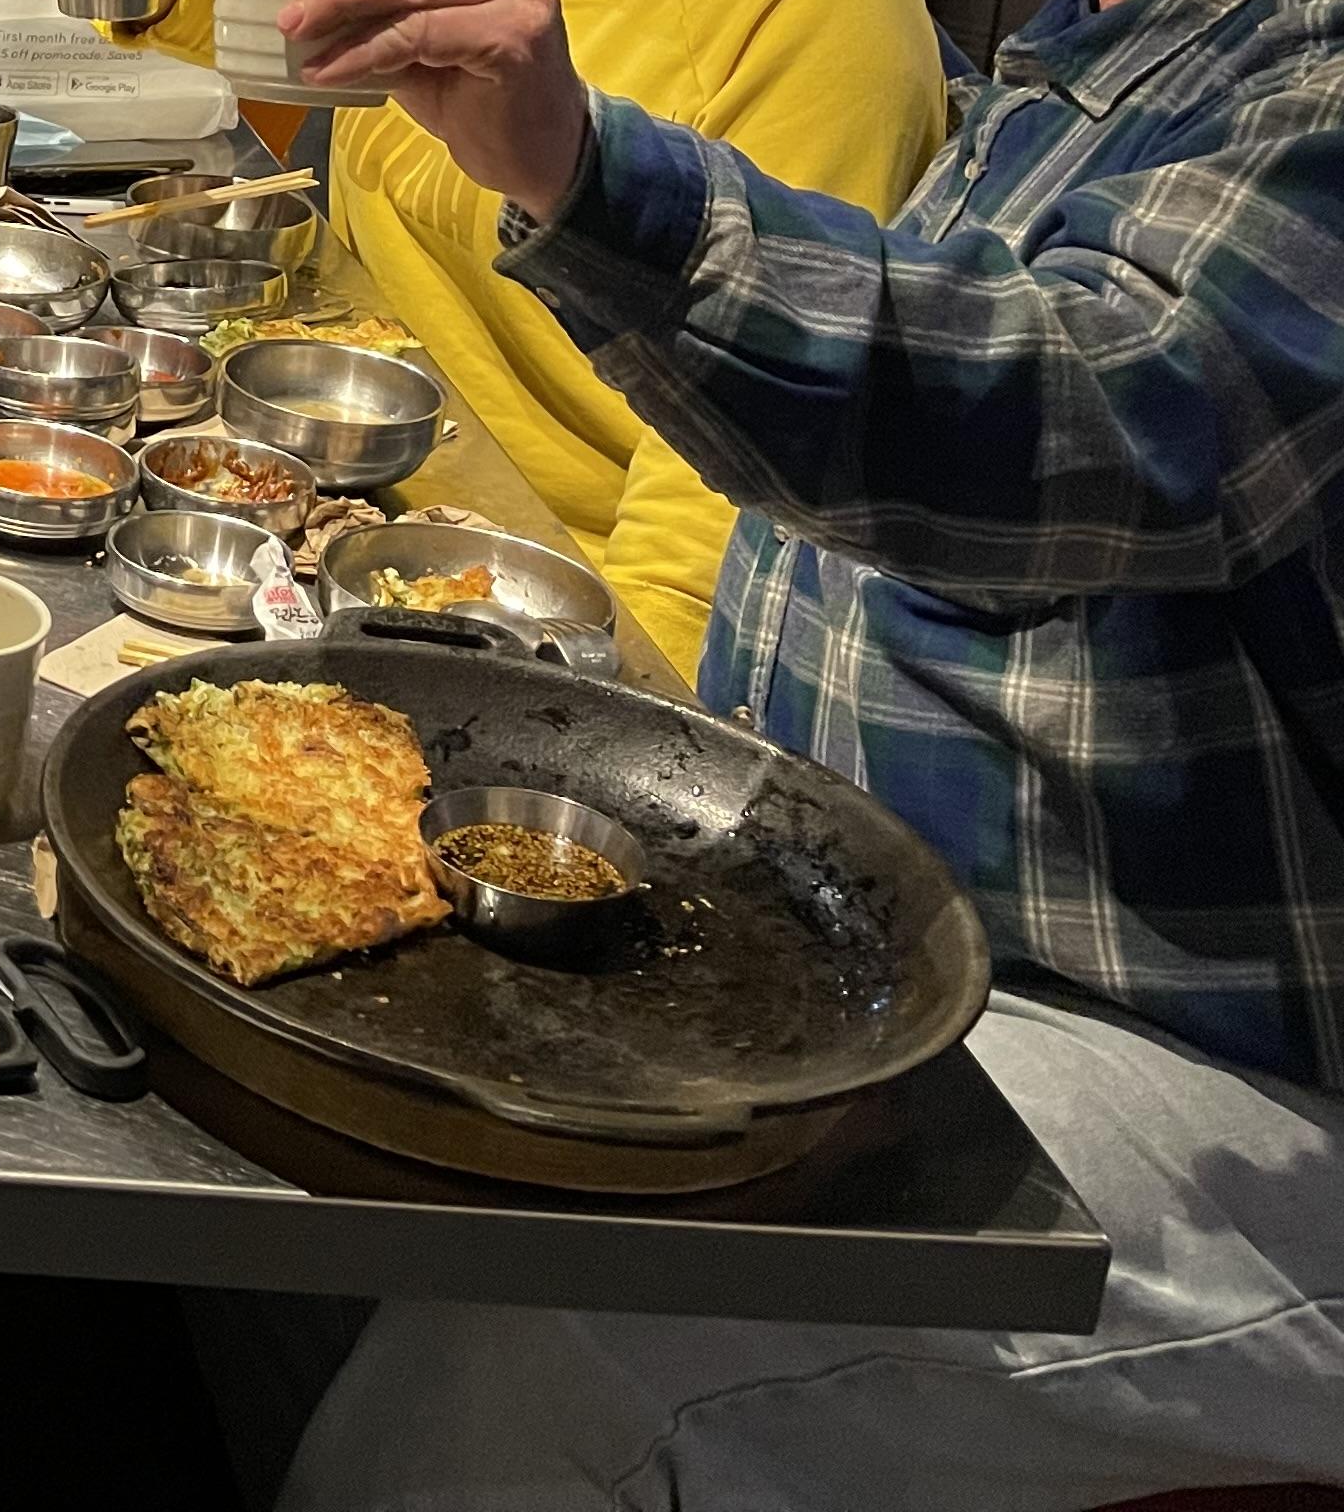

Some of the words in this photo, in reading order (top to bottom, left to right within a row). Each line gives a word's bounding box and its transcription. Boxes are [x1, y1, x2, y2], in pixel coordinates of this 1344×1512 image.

[26, 32, 67, 45] month
[70, 32, 95, 45] free
[10, 47, 29, 59] off
